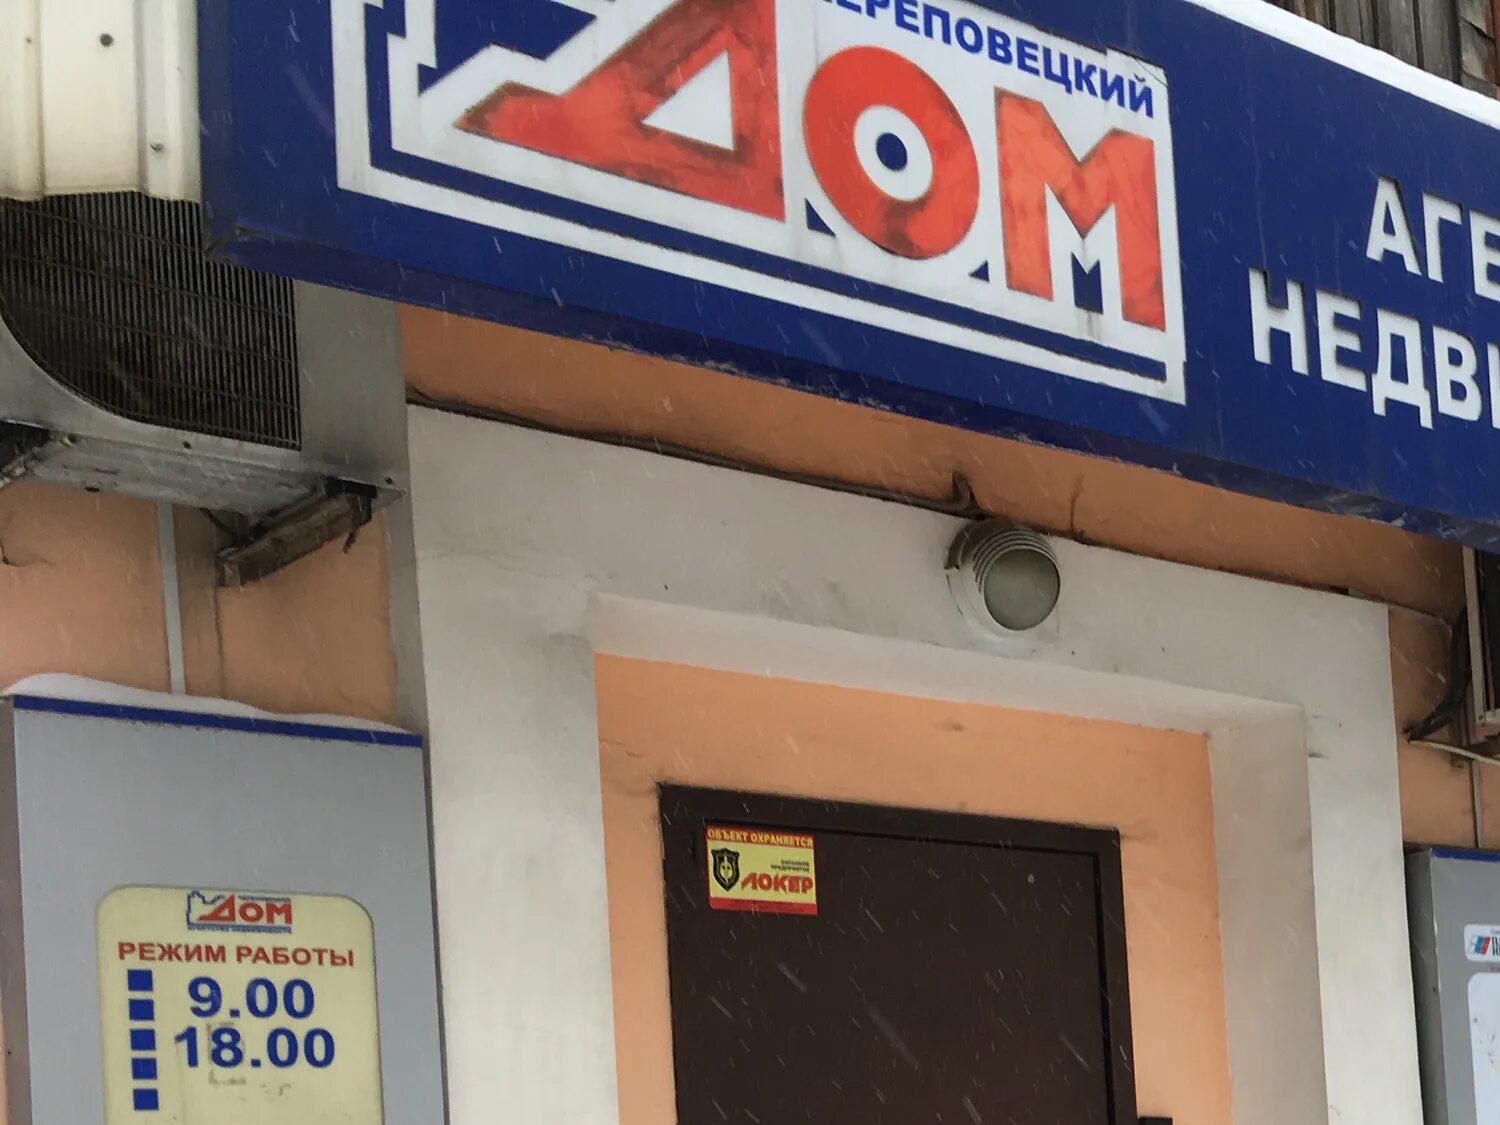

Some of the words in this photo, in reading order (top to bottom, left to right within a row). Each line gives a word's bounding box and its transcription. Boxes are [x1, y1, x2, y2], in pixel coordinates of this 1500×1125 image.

[824, 0, 1154, 118] РЕПОВЕЦКИЙ
[453, 0, 1168, 333] ДОМ
[707, 828, 749, 842] ОБЪЕКТ
[751, 832, 814, 848] ОХРАНЯЕТСЯ
[741, 872, 814, 894] ЛОКЕР
[196, 893, 293, 925] ДОМ
[117, 942, 227, 963] РЕЖИМ
[235, 945, 355, 968] РАБОТЫ
[187, 975, 315, 1020] 9.00
[174, 1025, 336, 1069] 18.00
